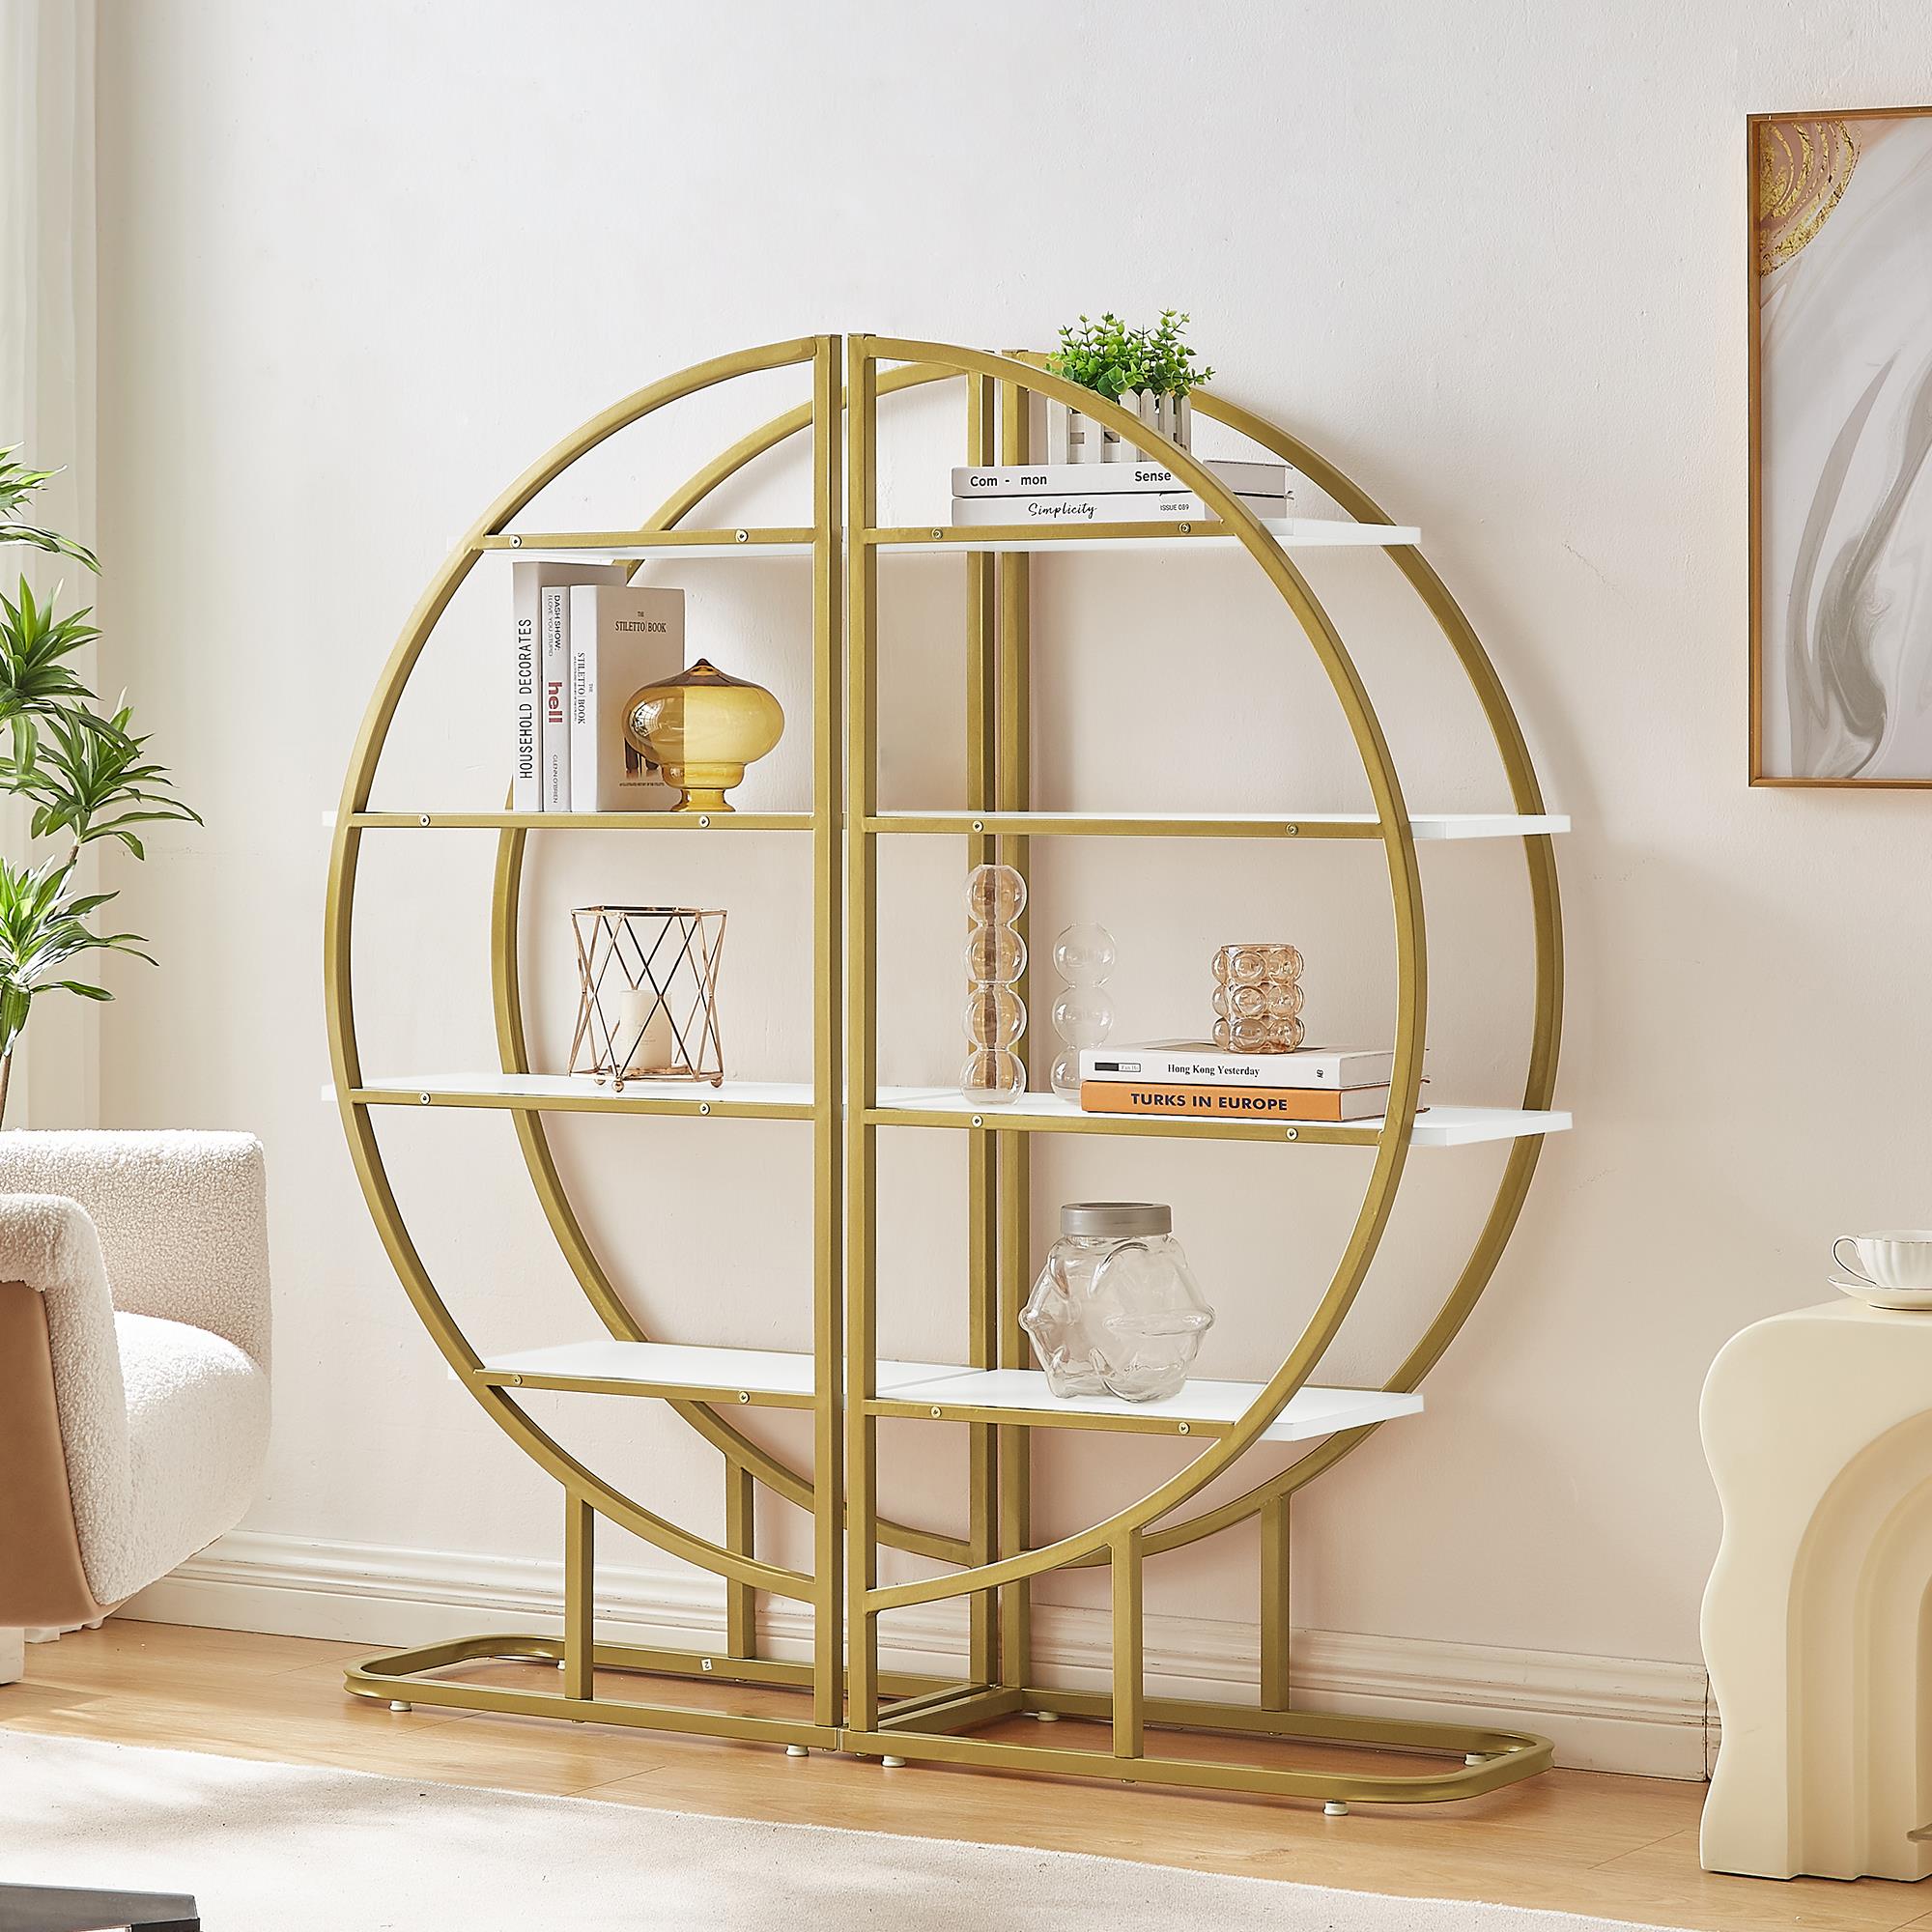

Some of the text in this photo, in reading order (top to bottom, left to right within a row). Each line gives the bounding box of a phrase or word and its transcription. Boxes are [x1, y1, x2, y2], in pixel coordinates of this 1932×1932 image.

[970, 475, 998, 487] Com
[1020, 475, 1047, 486] mon
[1134, 470, 1172, 482] Sense
[1028, 502, 1097, 519] Simplicity
[615, 620, 667, 633] STILETTO BOOK
[518, 618, 533, 779] HOUSEHOLD DECORATES
[548, 681, 563, 723] hell
[1168, 1064, 1261, 1078] Hong Kong Yesterday
[1130, 1093, 1288, 1111] TURKS IN EUROPE
